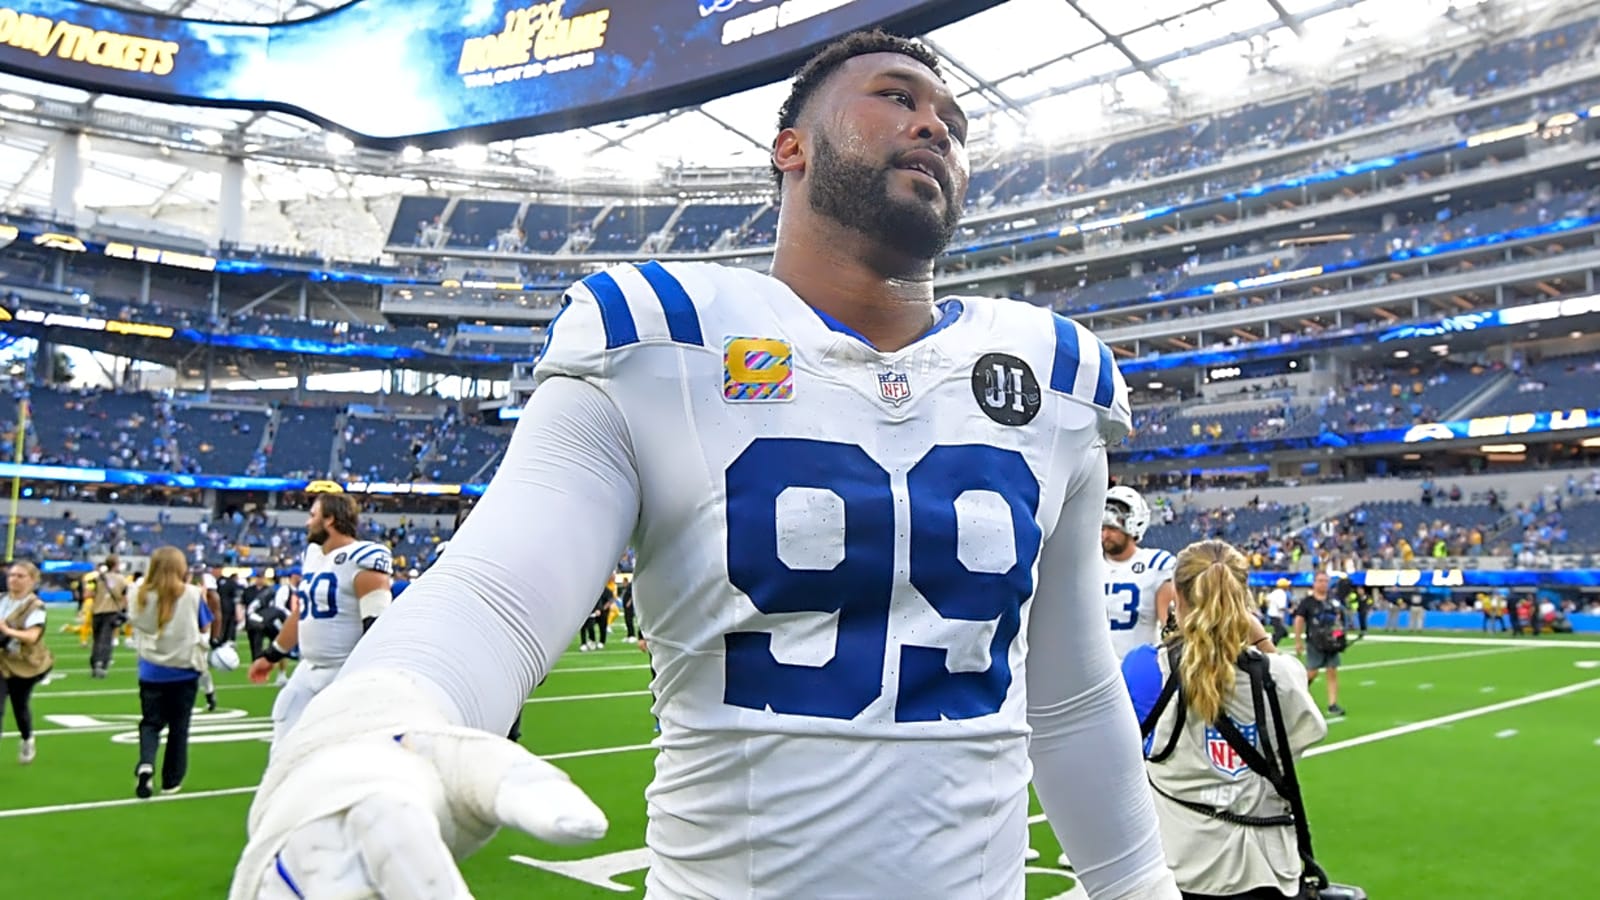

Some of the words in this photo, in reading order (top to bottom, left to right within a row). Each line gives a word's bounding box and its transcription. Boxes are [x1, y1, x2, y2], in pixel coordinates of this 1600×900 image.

[883, 383, 909, 398] NFL
[723, 438, 1042, 723] 99
[1105, 583, 1140, 631] 3
